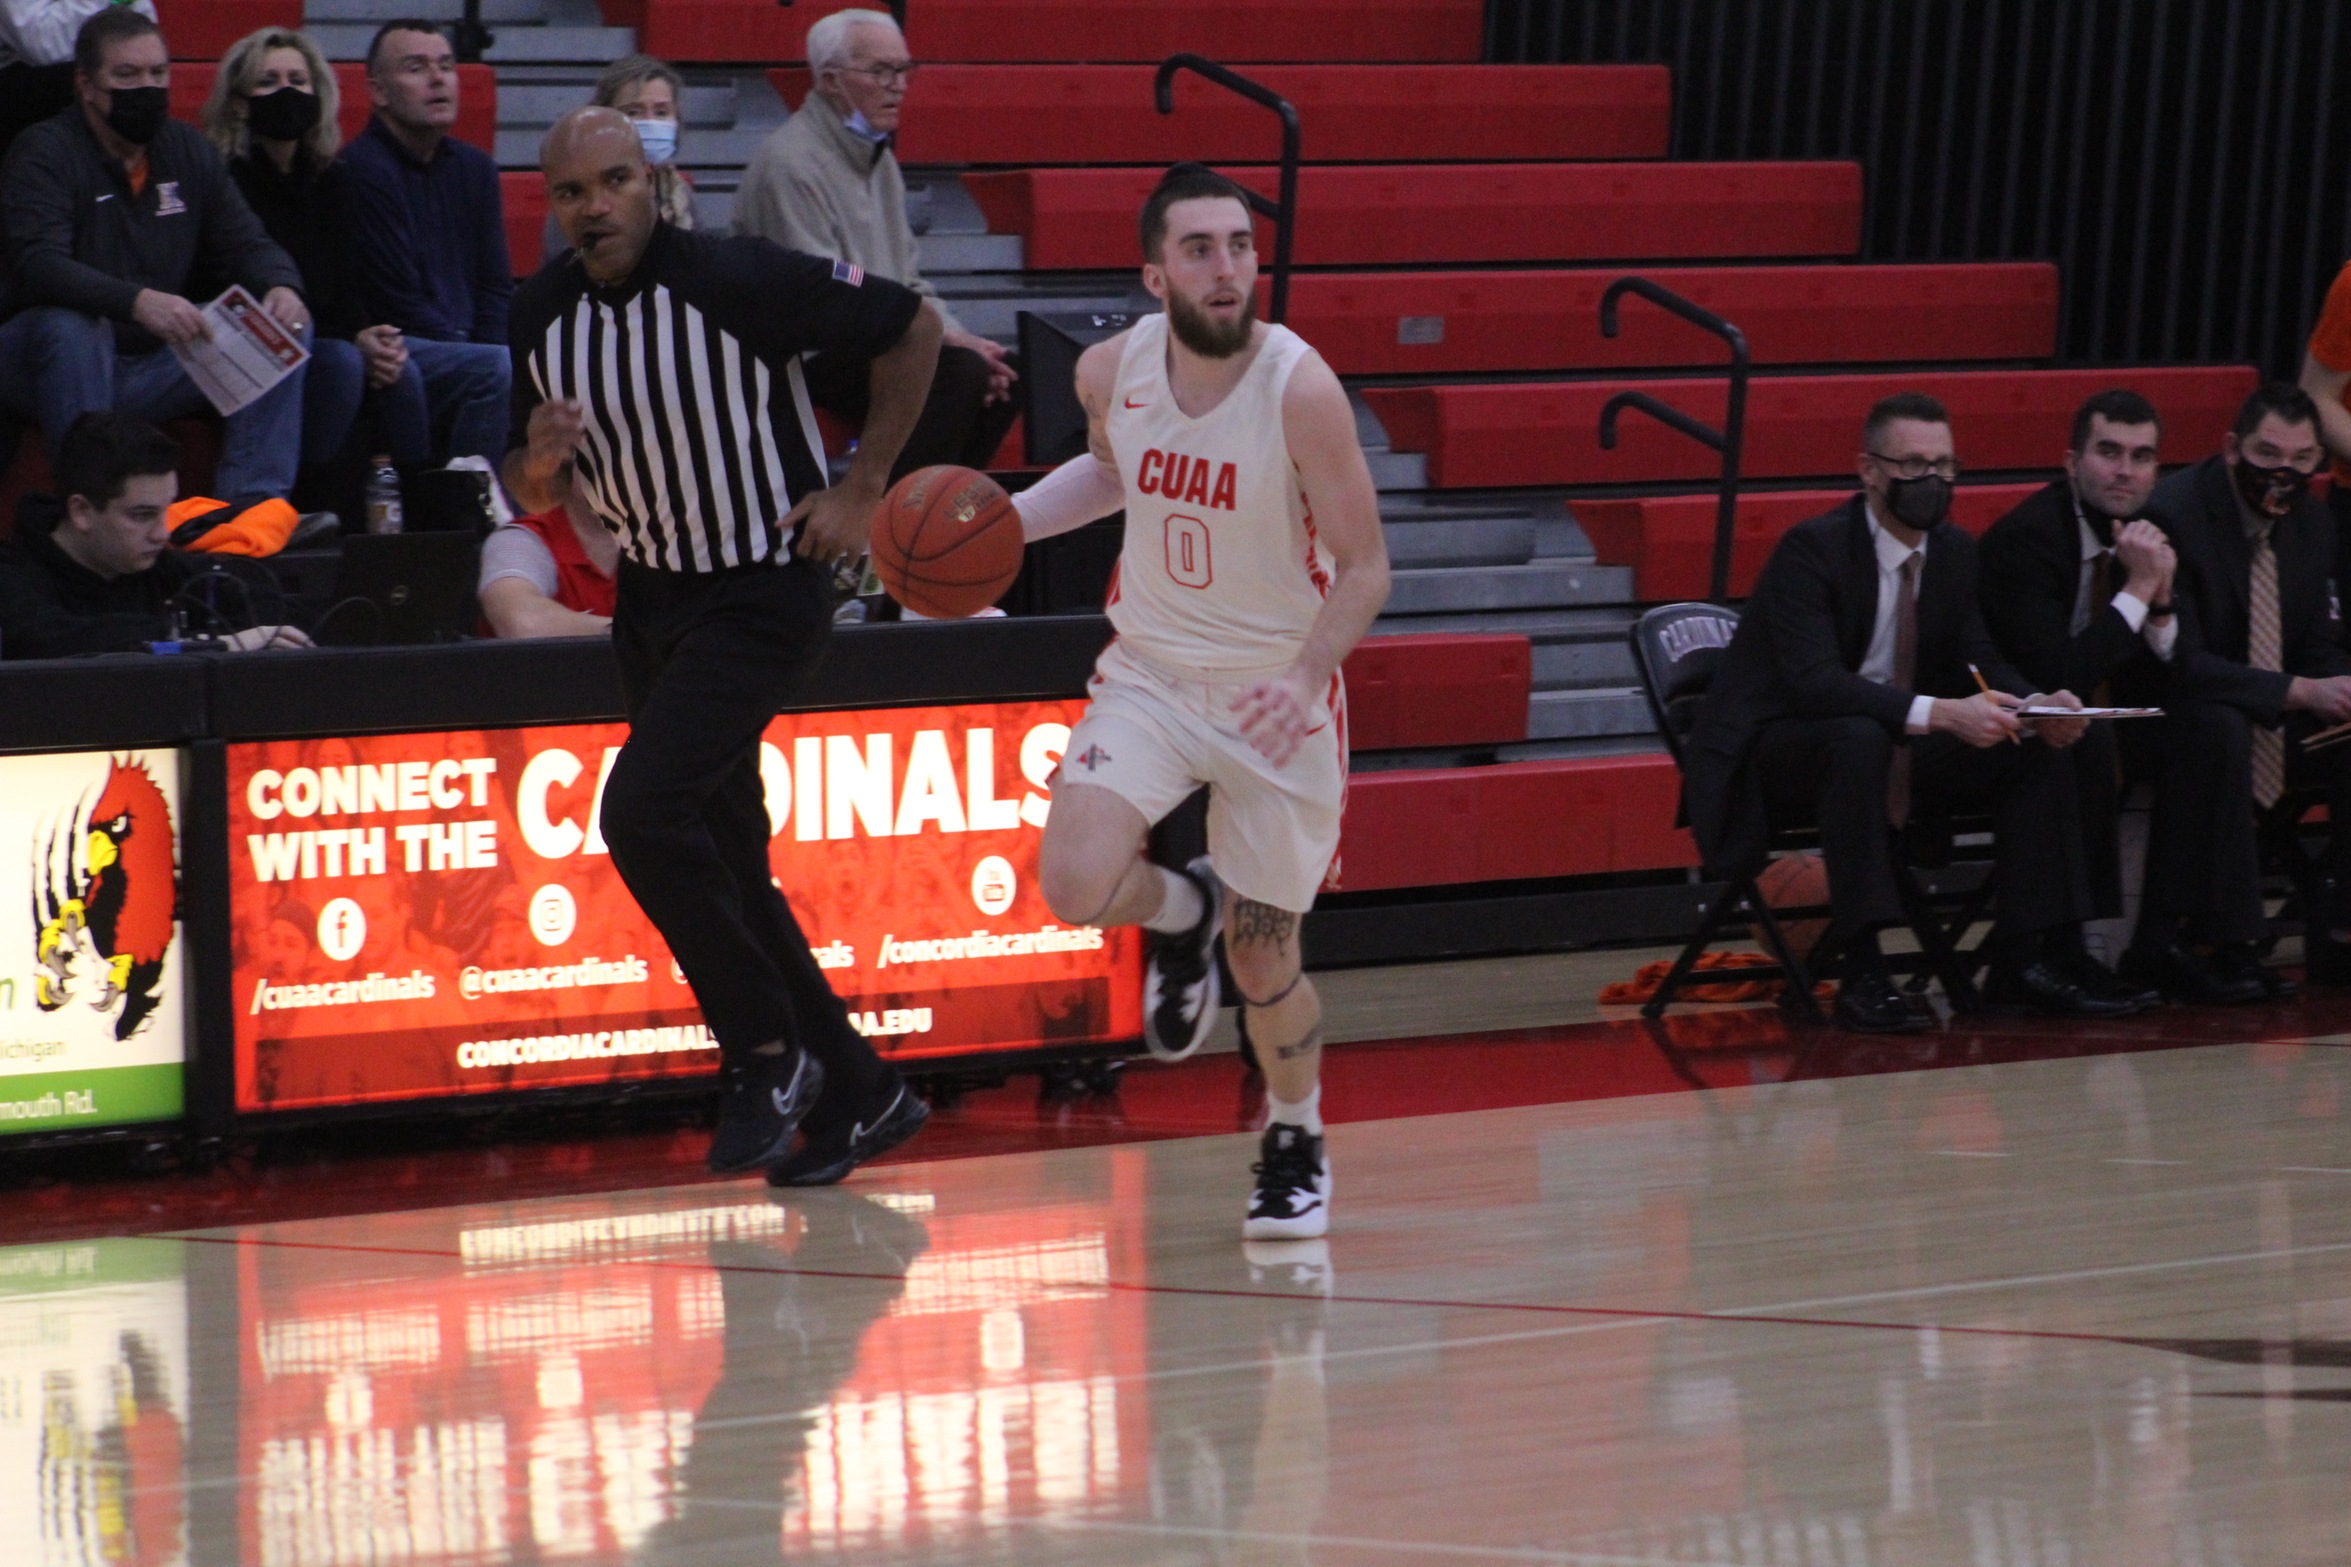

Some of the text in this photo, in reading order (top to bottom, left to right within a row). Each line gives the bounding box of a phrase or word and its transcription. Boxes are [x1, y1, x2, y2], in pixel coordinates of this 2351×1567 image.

[1137, 448, 1237, 511] CUAA
[1164, 513, 1213, 590] 0
[247, 757, 497, 820] CONNECT
[517, 723, 1072, 859] CDINALS
[247, 820, 498, 882] WITH THE
[249, 969, 435, 1016] /cuaacardinals
[458, 954, 648, 1000] @cuaacardinals
[876, 925, 1104, 968] /concordiacardinals
[0, 1038, 66, 1062] ichigan
[457, 1007, 932, 1068] CONCORDIACARDINAL A.EDU
[0, 1089, 97, 1120] mouth Rd.
